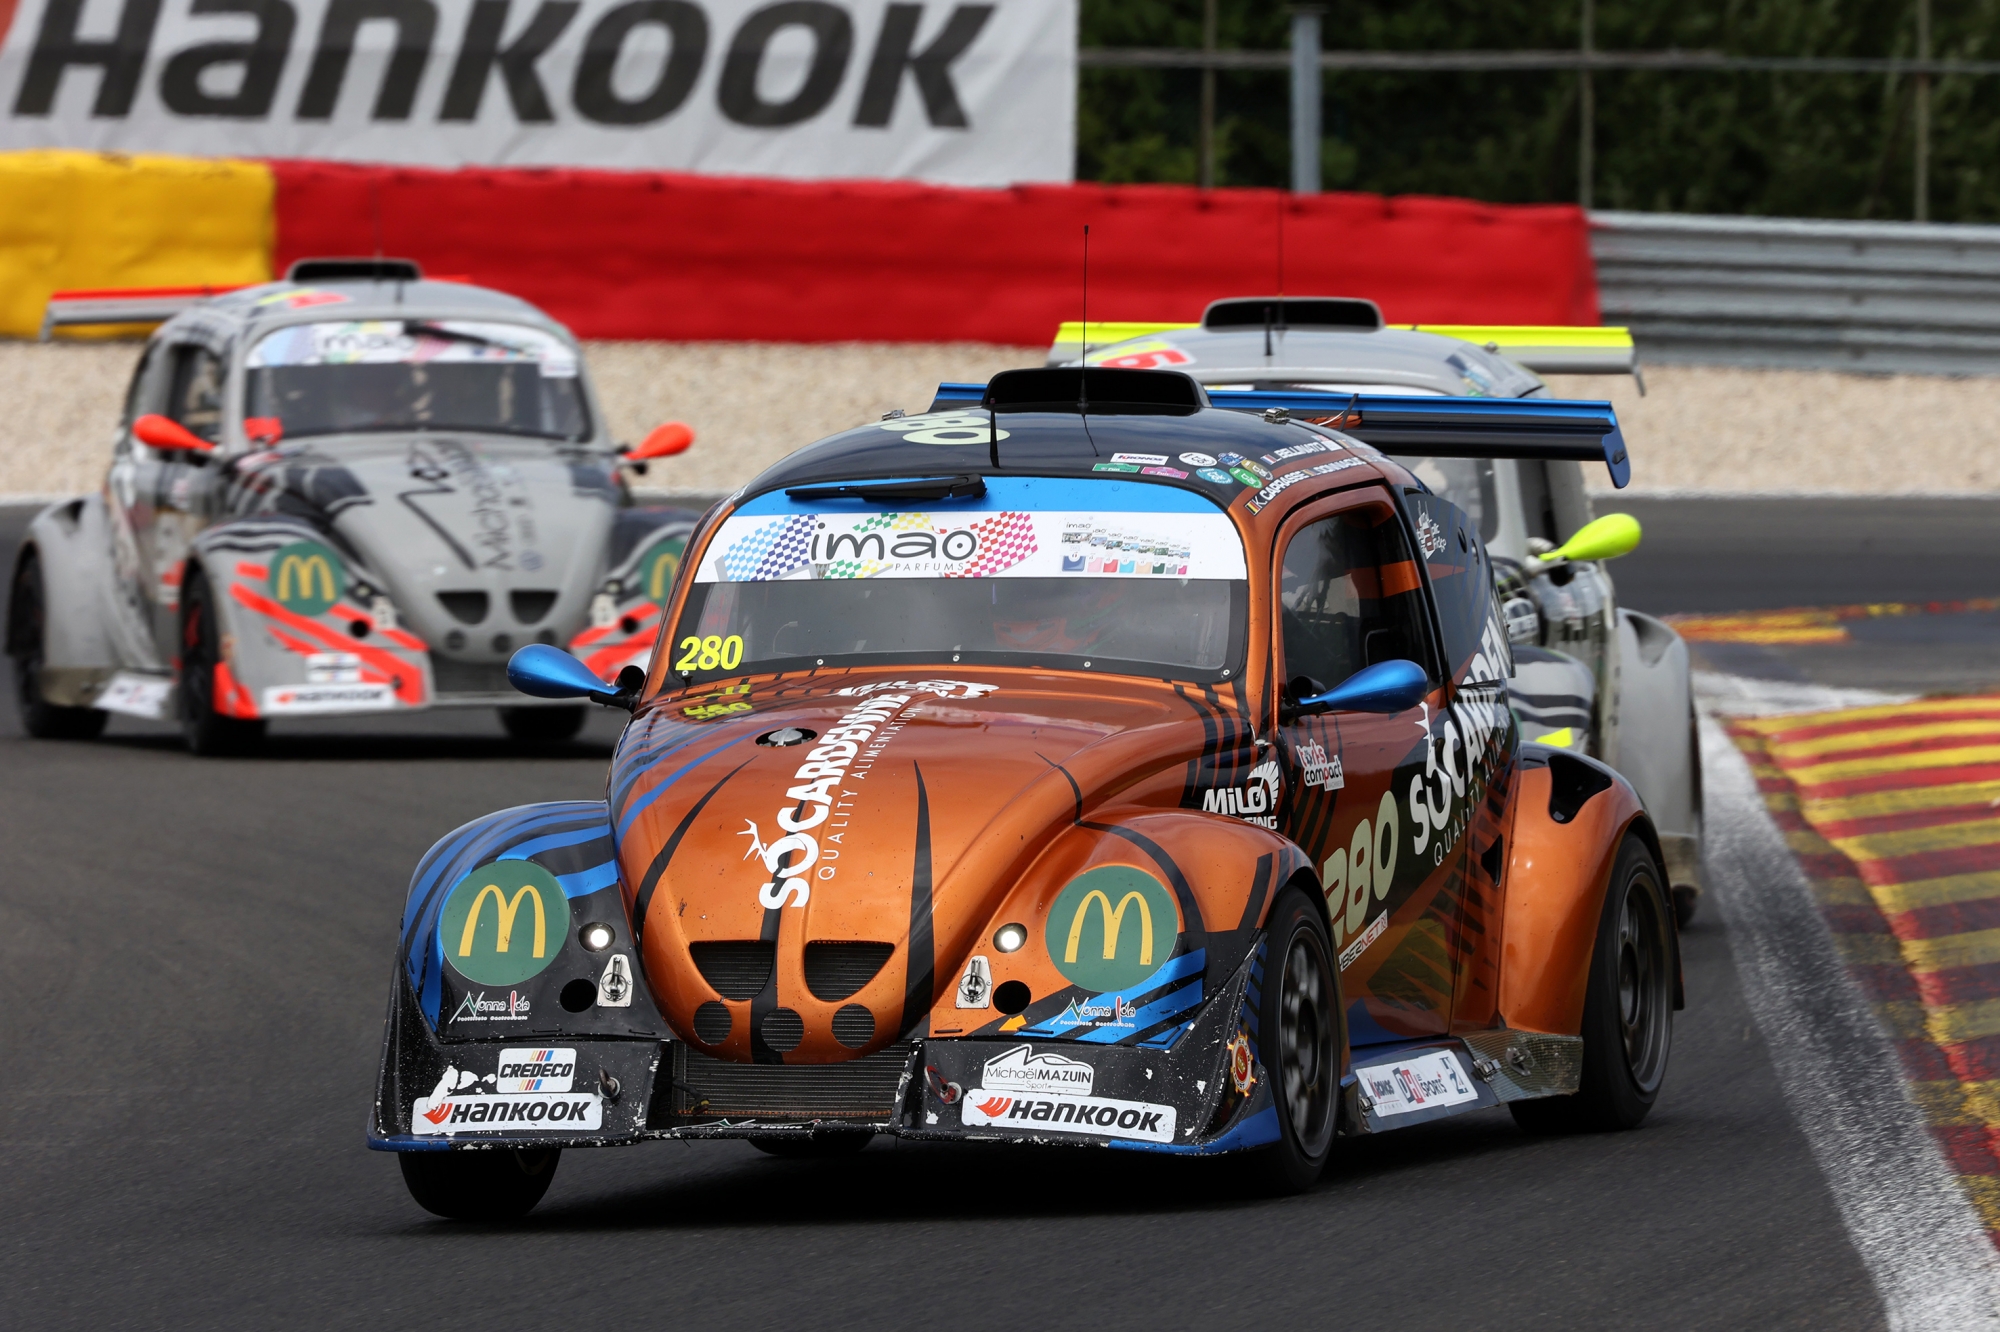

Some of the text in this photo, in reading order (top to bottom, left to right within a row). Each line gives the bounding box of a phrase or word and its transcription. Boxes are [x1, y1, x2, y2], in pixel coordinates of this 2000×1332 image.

[1259, 471, 1310, 501] CAPRASSE
[811, 522, 976, 560] imao
[895, 563, 964, 572] PARFUMS
[675, 635, 744, 671] 280
[1305, 758, 1343, 789] compact
[758, 693, 912, 910] SOCARDENNE
[818, 707, 923, 881] QUALITY ALIMENTATION
[1323, 790, 1399, 949] 280
[448, 990, 530, 1024] Nonna Ida
[1050, 996, 1136, 1025] Nonna Ida
[499, 1063, 573, 1078] CREDECO
[1026, 1080, 1048, 1090] Sport
